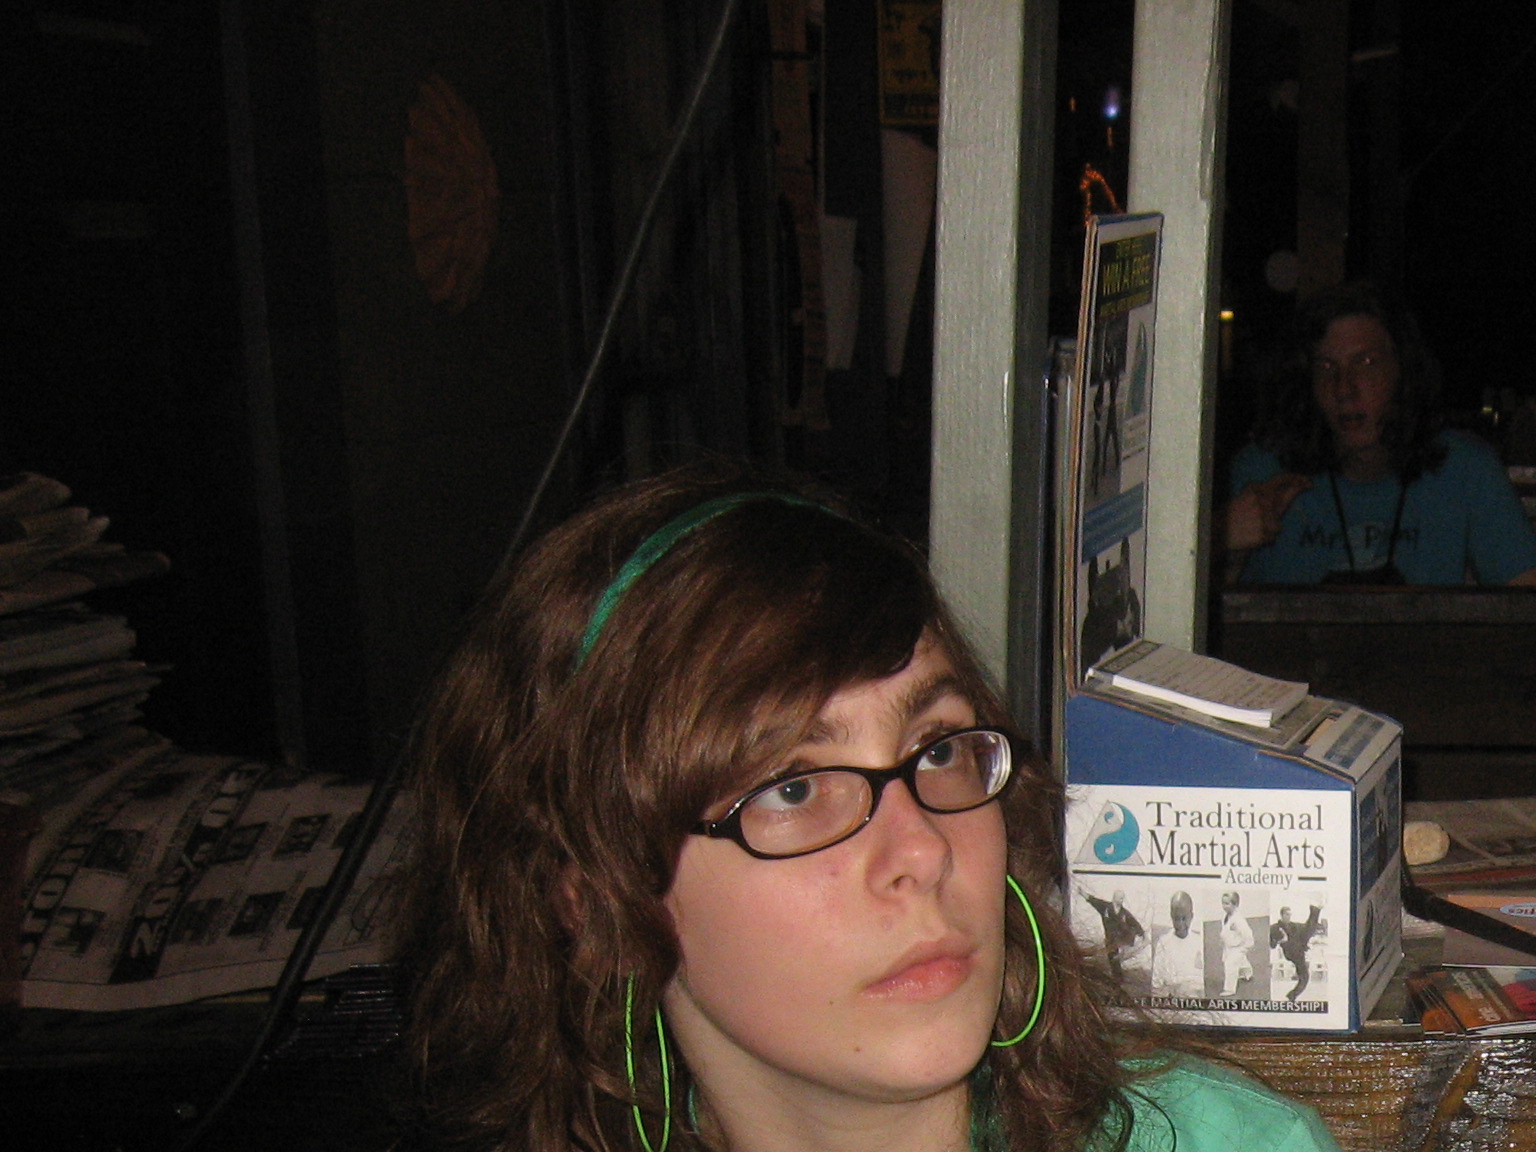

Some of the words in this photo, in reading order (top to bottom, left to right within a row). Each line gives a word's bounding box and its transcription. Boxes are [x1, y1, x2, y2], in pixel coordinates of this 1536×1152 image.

[1145, 801, 1325, 831] Traditional
[1147, 829, 1251, 867] Martial
[1262, 832, 1326, 869] Arts
[1224, 868, 1293, 890] Academy
[1209, 999, 1238, 1010] ARTS
[1241, 1000, 1324, 1012] MEMBERSHIP!
